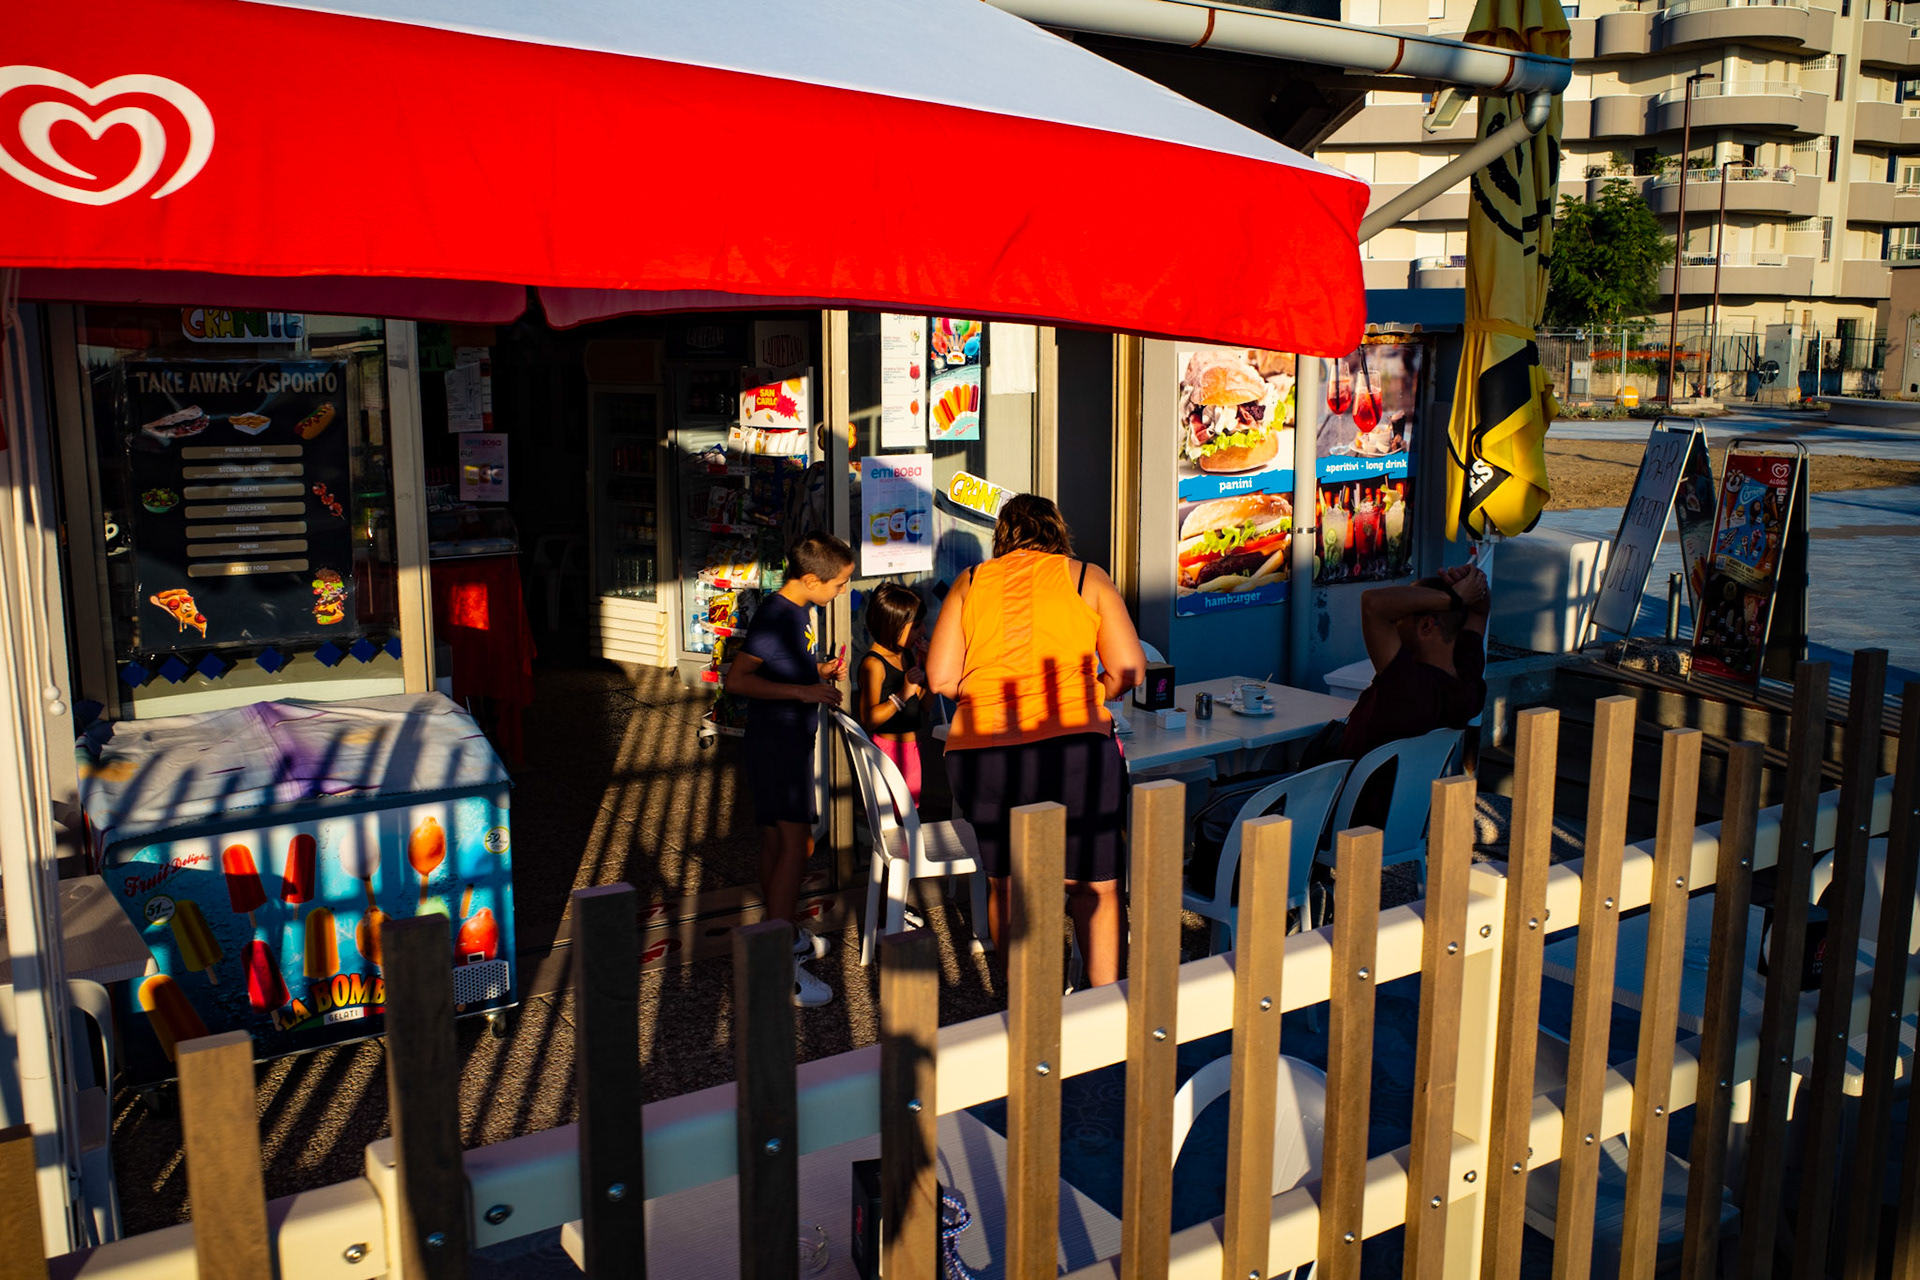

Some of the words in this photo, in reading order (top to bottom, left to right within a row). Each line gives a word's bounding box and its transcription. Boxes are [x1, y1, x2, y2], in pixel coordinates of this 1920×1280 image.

[136, 372, 185, 393] TAKE
[188, 372, 240, 393] AWAY
[256, 371, 338, 394] ASPORTO
[758, 388, 776, 398] SAN
[1325, 461, 1359, 474] aperitivi
[1366, 460, 1384, 472] long
[1385, 457, 1407, 470] drink
[1644, 440, 1680, 485] BAR
[1219, 477, 1253, 494] panini
[1204, 590, 1262, 609] hamburger
[124, 863, 170, 897] Fruit
[147, 902, 162, 917] 51
[280, 998, 312, 1031] LA
[311, 973, 387, 1014] BOMB
[328, 1009, 359, 1022] GELATI
